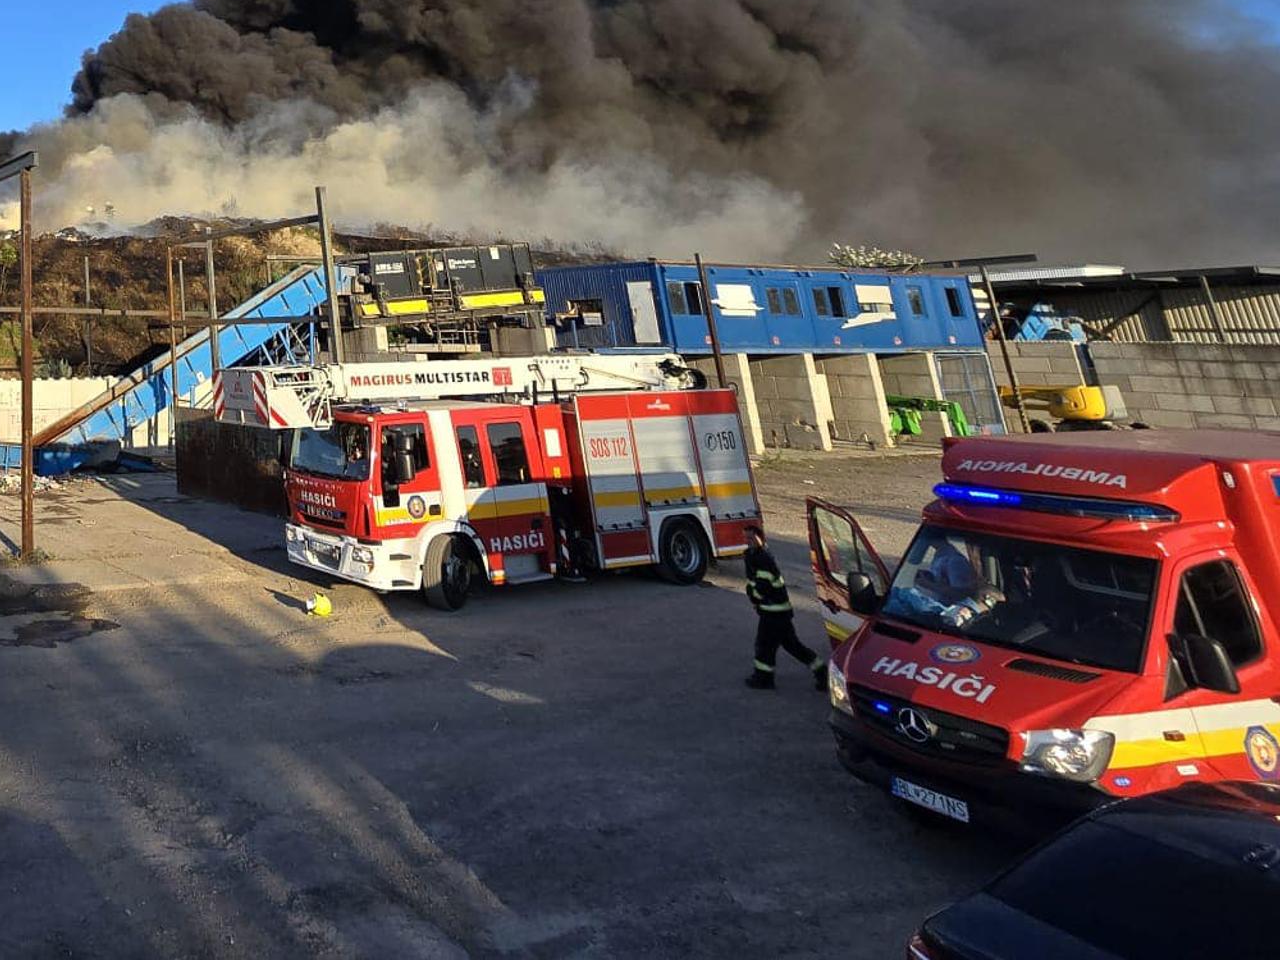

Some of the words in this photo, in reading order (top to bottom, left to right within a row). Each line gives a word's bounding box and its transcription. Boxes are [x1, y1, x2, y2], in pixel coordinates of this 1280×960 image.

[350, 374, 412, 387] MAGIRUS
[415, 371, 490, 384] MULTISTAR
[590, 437, 611, 458] SOS
[612, 436, 629, 457] 112
[716, 431, 736, 451] 150
[301, 490, 337, 508] HASIČI
[489, 529, 546, 552] HASIČI
[871, 656, 997, 704] HASIČI
